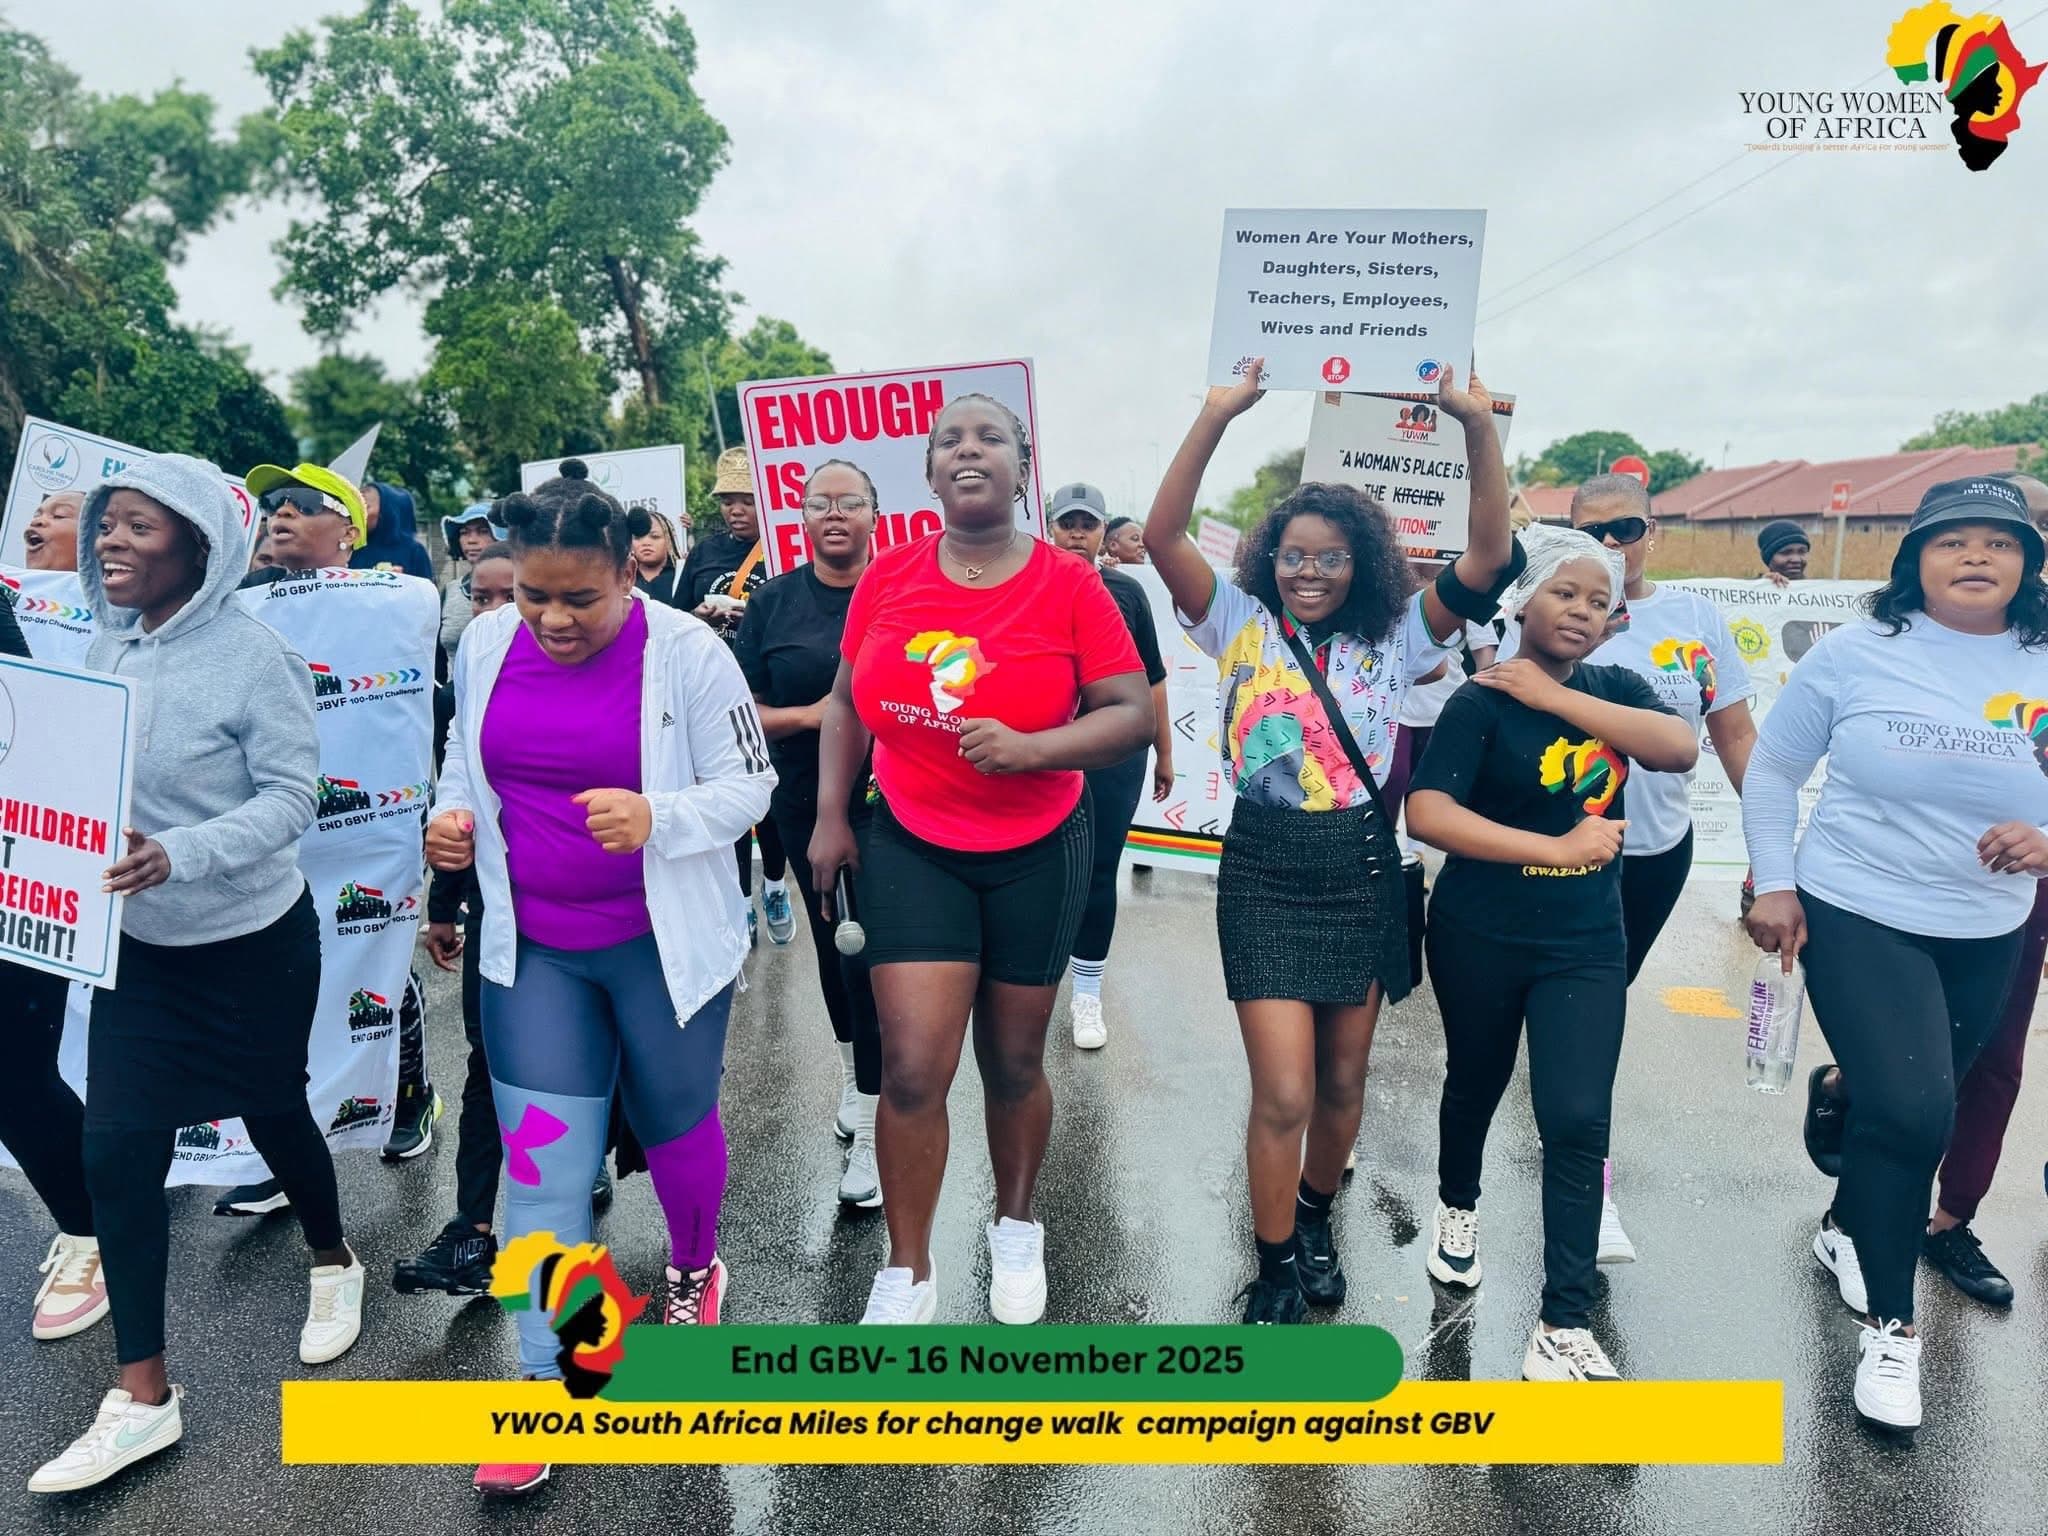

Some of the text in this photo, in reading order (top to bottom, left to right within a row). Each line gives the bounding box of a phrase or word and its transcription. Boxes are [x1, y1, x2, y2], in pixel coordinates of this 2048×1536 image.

[1235, 230, 1474, 248] Women Are Your Mothers,
[1262, 261, 1439, 278] Daughters, Sisters,
[1248, 291, 1449, 310] Teachers, Employees,
[1260, 321, 1428, 337] Wives and Friends
[753, 380, 944, 449] ENOUGH
[1402, 430, 1429, 440] YUWM
[1413, 458, 1452, 478] PLACE
[1453, 463, 1465, 480] IS
[765, 462, 806, 510] IS
[1392, 486, 1445, 507] KITCHEN
[289, 582, 322, 596] GBVF
[1788, 593, 1855, 609] AGAINST
[1647, 675, 1692, 685] OMEN
[350, 694, 384, 705] 100-Day
[385, 687, 424, 698] Challenges
[880, 700, 931, 718] YOUNG
[897, 714, 918, 725] OF
[1886, 720, 2027, 745] YOUNG WOMEN
[1899, 734, 1929, 748] OF
[1934, 738, 2016, 757] AFRICA
[0, 798, 107, 855] HILDREN
[318, 820, 342, 831] END
[344, 812, 376, 826] GBVF
[380, 806, 413, 819] 100-Day
[337, 926, 361, 936] END
[1748, 980, 1767, 1037] ALKALINE
[173, 1151, 193, 1160] END
